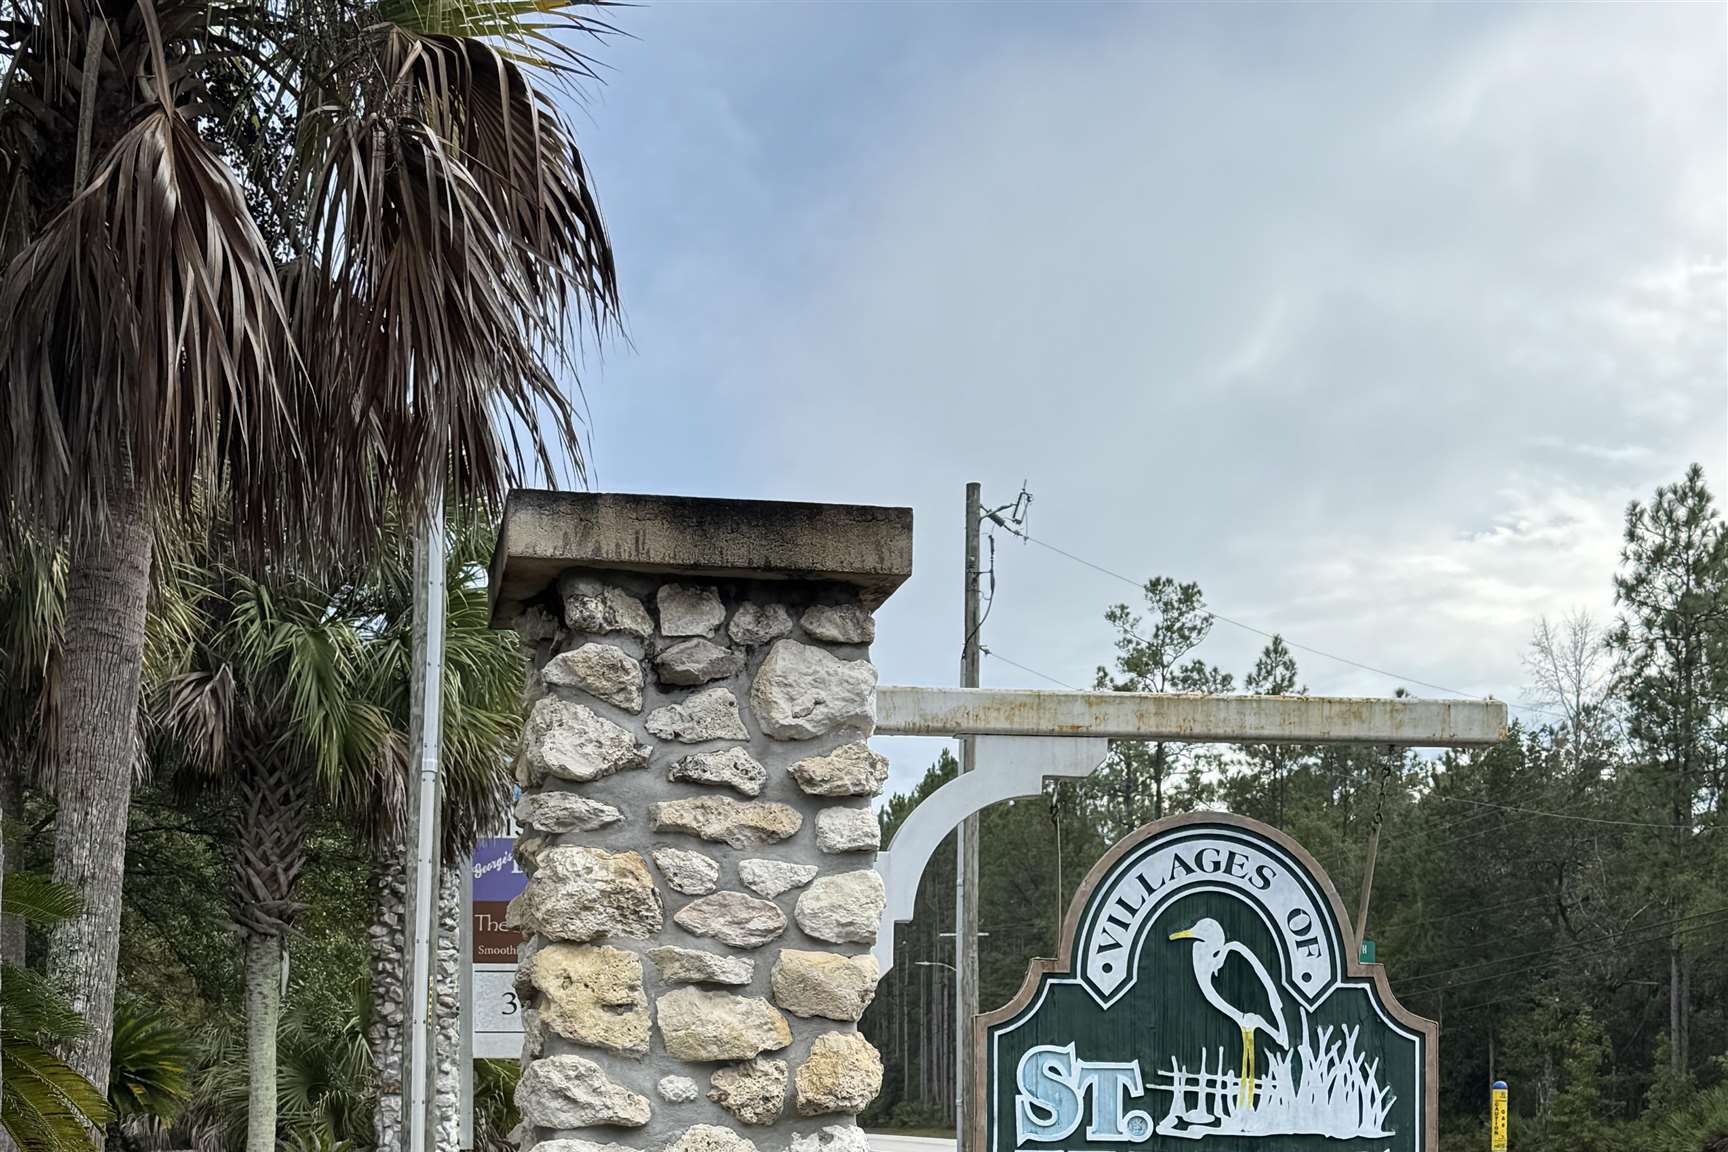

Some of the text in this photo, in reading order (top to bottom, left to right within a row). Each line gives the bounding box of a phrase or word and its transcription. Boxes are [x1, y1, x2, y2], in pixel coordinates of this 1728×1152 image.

[1095, 847, 1322, 959] VILLAGES OF
[1015, 1040, 1153, 1146] ST.
